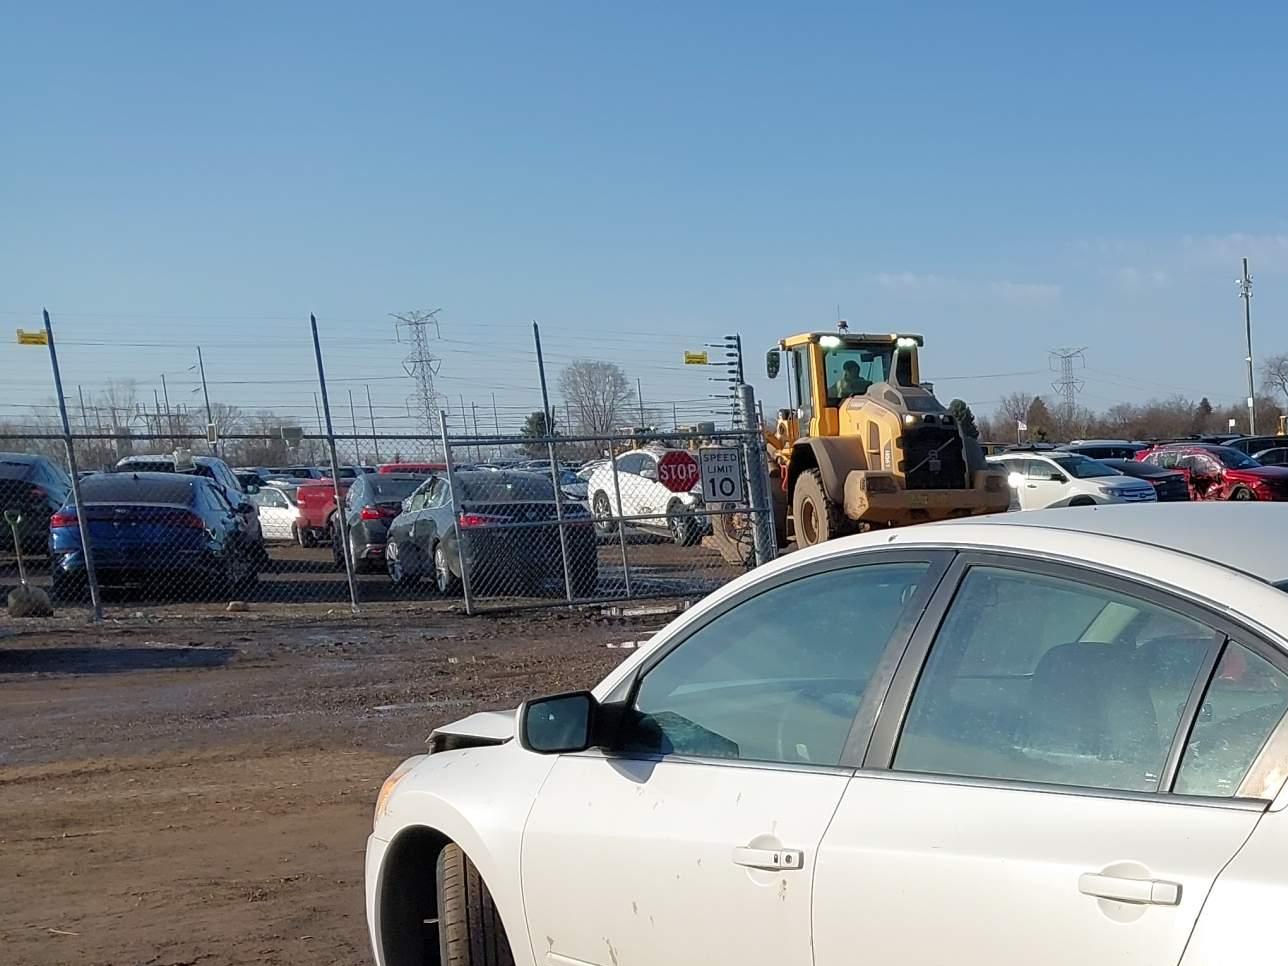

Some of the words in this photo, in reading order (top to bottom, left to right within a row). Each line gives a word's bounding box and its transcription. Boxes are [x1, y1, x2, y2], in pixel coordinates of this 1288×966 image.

[703, 453, 737, 462] SPEED
[660, 463, 697, 480] STOP
[707, 464, 733, 474] LIMIT
[708, 477, 735, 497] 10
